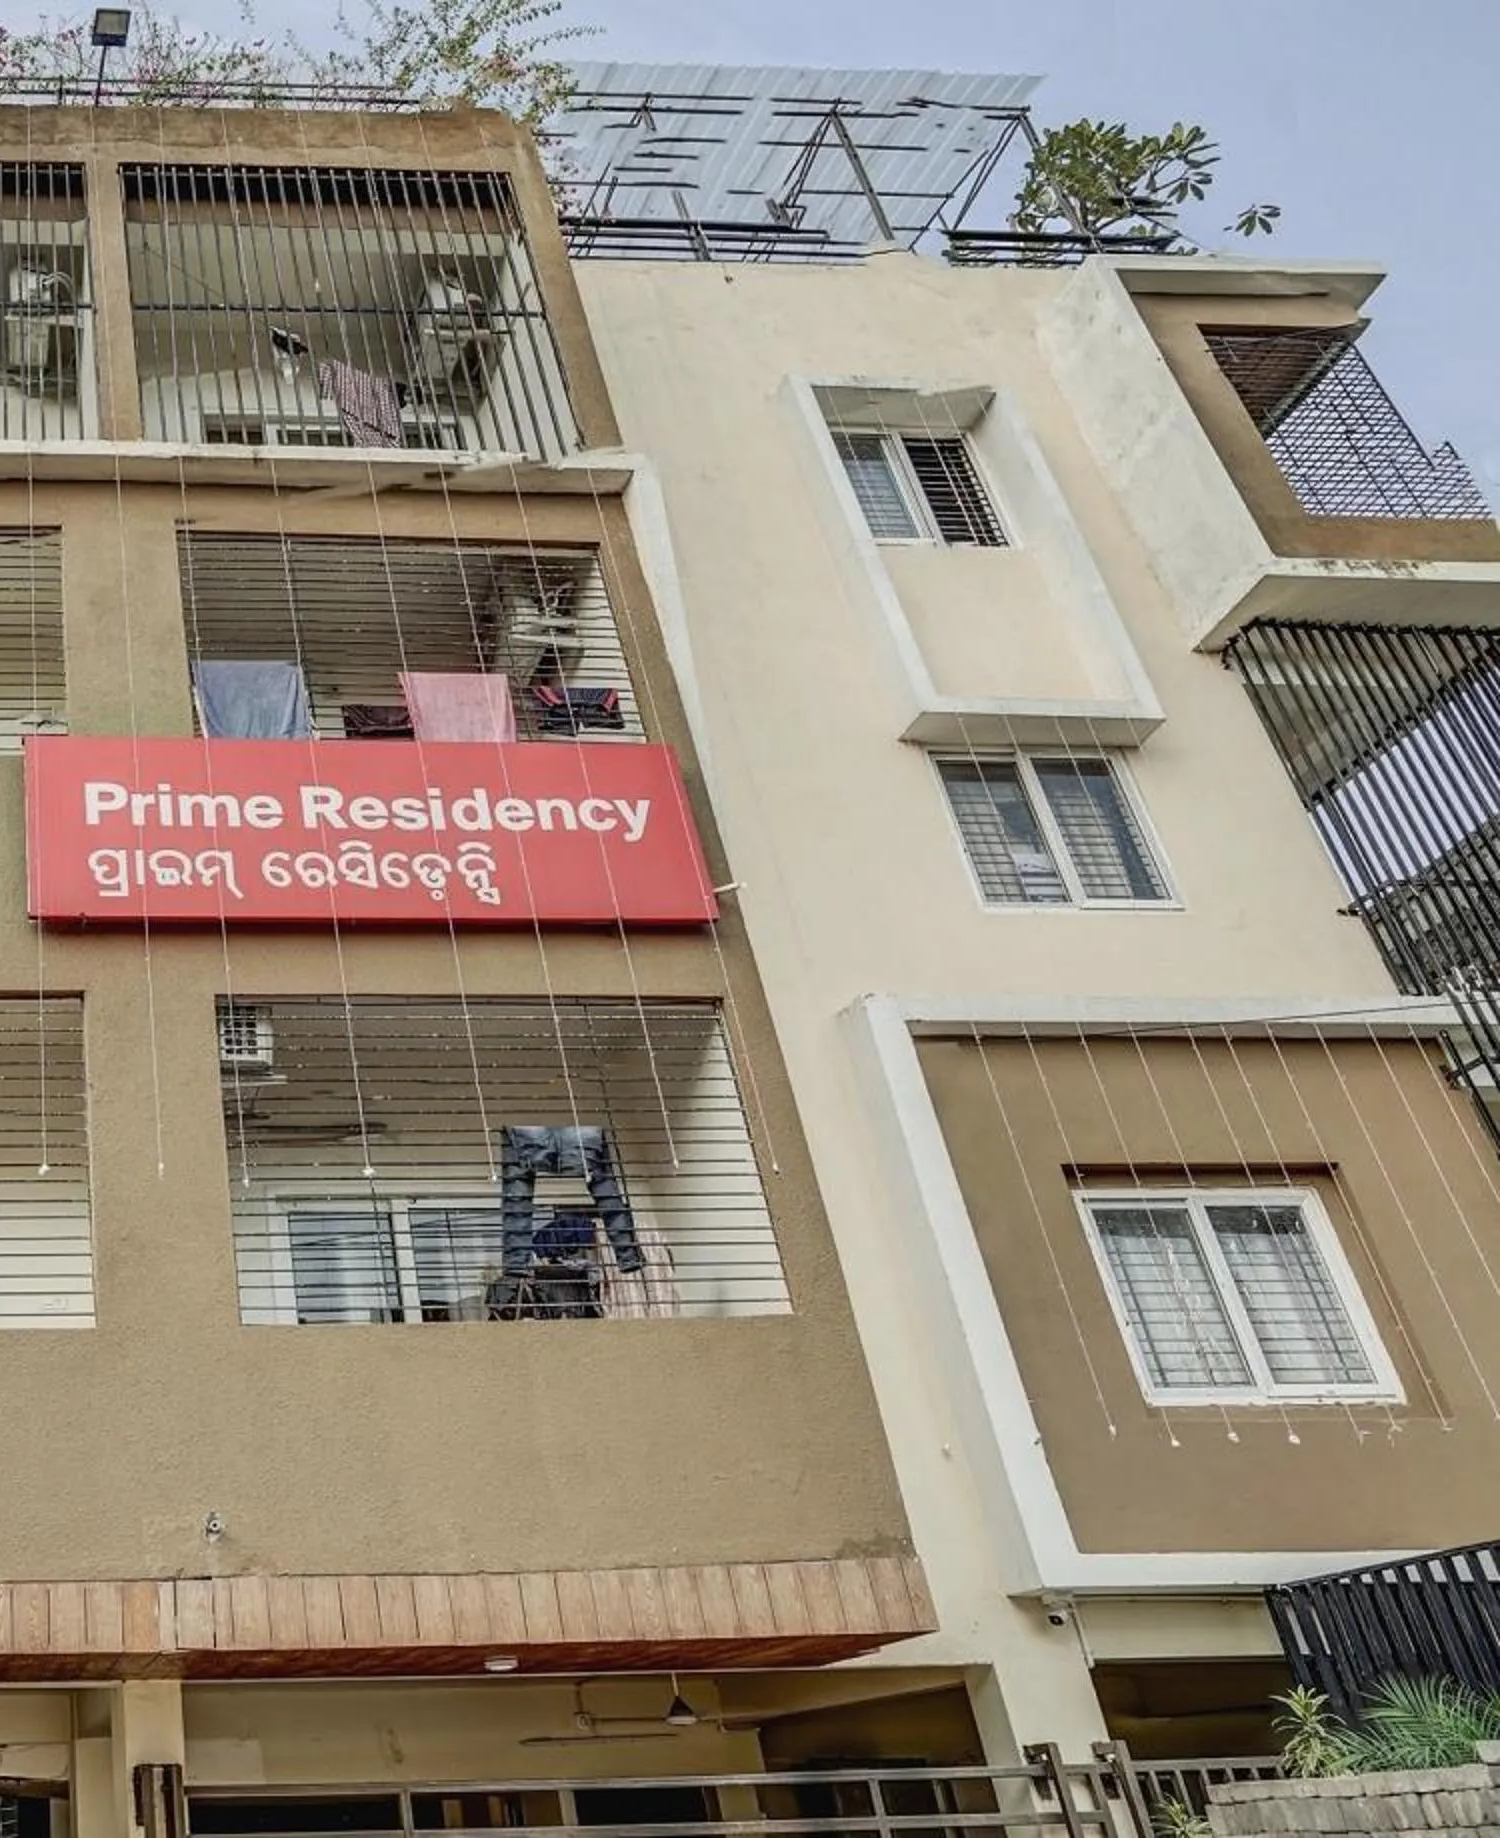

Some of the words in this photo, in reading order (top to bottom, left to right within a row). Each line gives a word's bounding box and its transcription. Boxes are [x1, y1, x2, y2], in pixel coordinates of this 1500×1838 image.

[85, 782, 282, 828] Prime
[299, 785, 650, 842] Residency
[88, 844, 244, 898] ପ୍ରାଇମ୍
